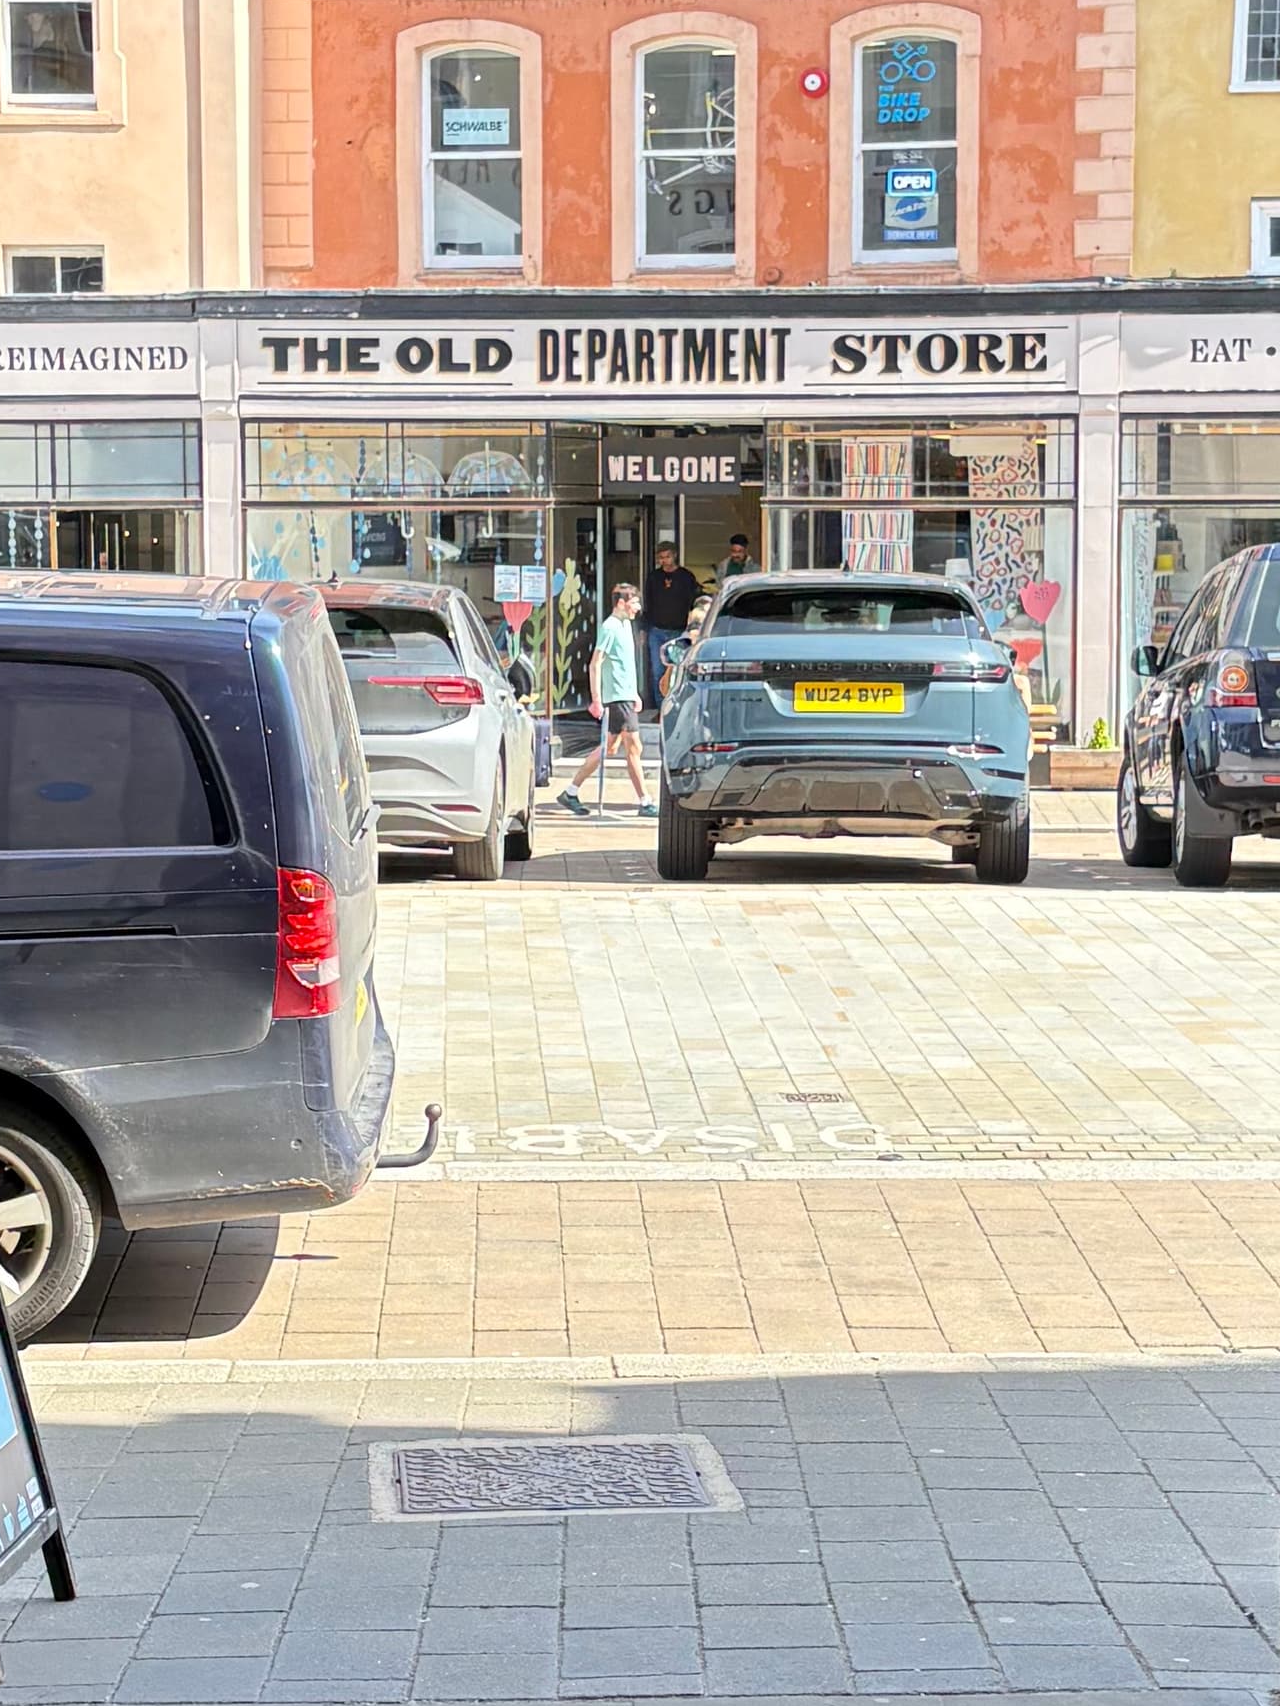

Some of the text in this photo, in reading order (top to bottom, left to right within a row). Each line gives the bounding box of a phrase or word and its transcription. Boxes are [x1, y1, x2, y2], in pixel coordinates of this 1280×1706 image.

[878, 93, 921, 107] BIKE
[878, 108, 930, 124] DROP
[445, 120, 503, 133] SCHWALBE
[893, 175, 931, 190] OPEN
[261, 328, 1048, 383] THE OLD DEPARTMENT STORE
[1190, 337, 1252, 363] EAT
[606, 454, 736, 482] WELCOME
[804, 687, 894, 703] WU24 BVP
